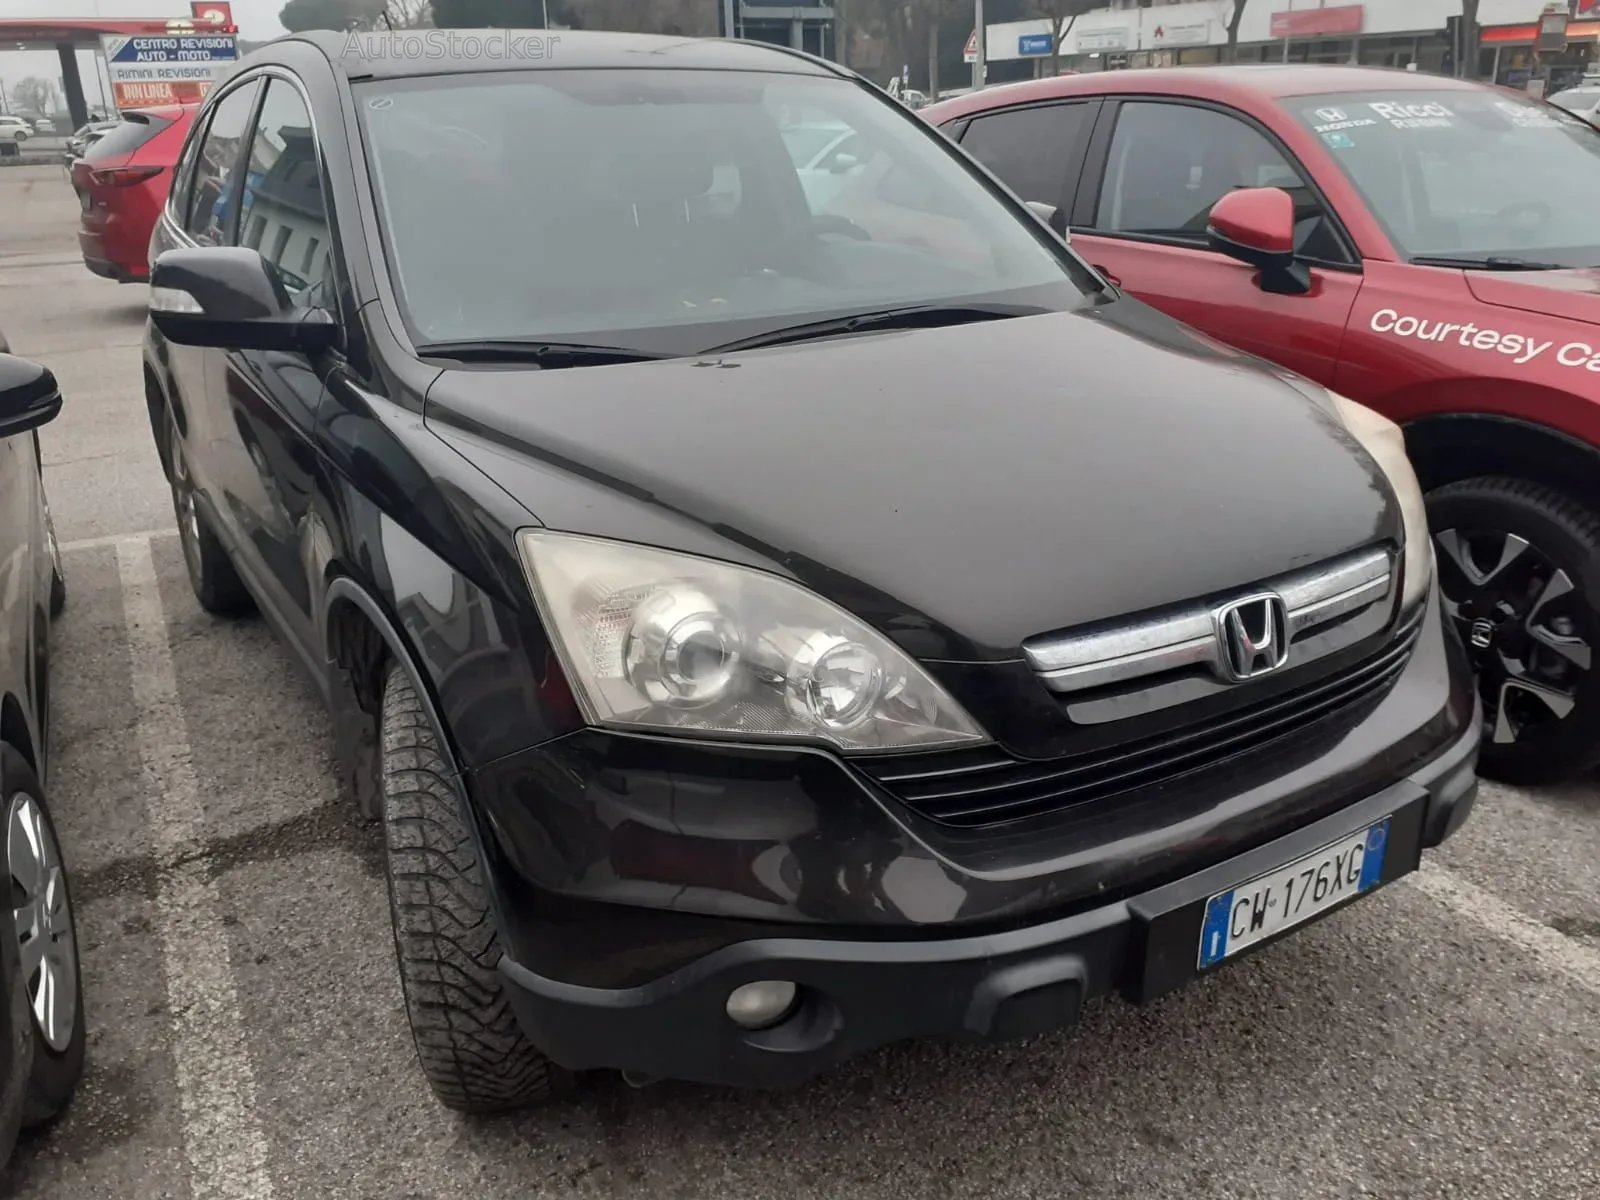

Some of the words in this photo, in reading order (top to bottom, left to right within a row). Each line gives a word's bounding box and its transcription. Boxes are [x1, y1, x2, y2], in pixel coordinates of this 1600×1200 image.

[133, 39, 178, 50] CENTRO
[181, 38, 233, 49] REVISIONI
[136, 51, 168, 62] AUTO
[178, 50, 211, 61] MOTO
[117, 69, 153, 79] RIMINI
[158, 67, 211, 79] REVISIONI
[1368, 102, 1455, 119] Ricci
[1370, 308, 1553, 364] Courtesy
